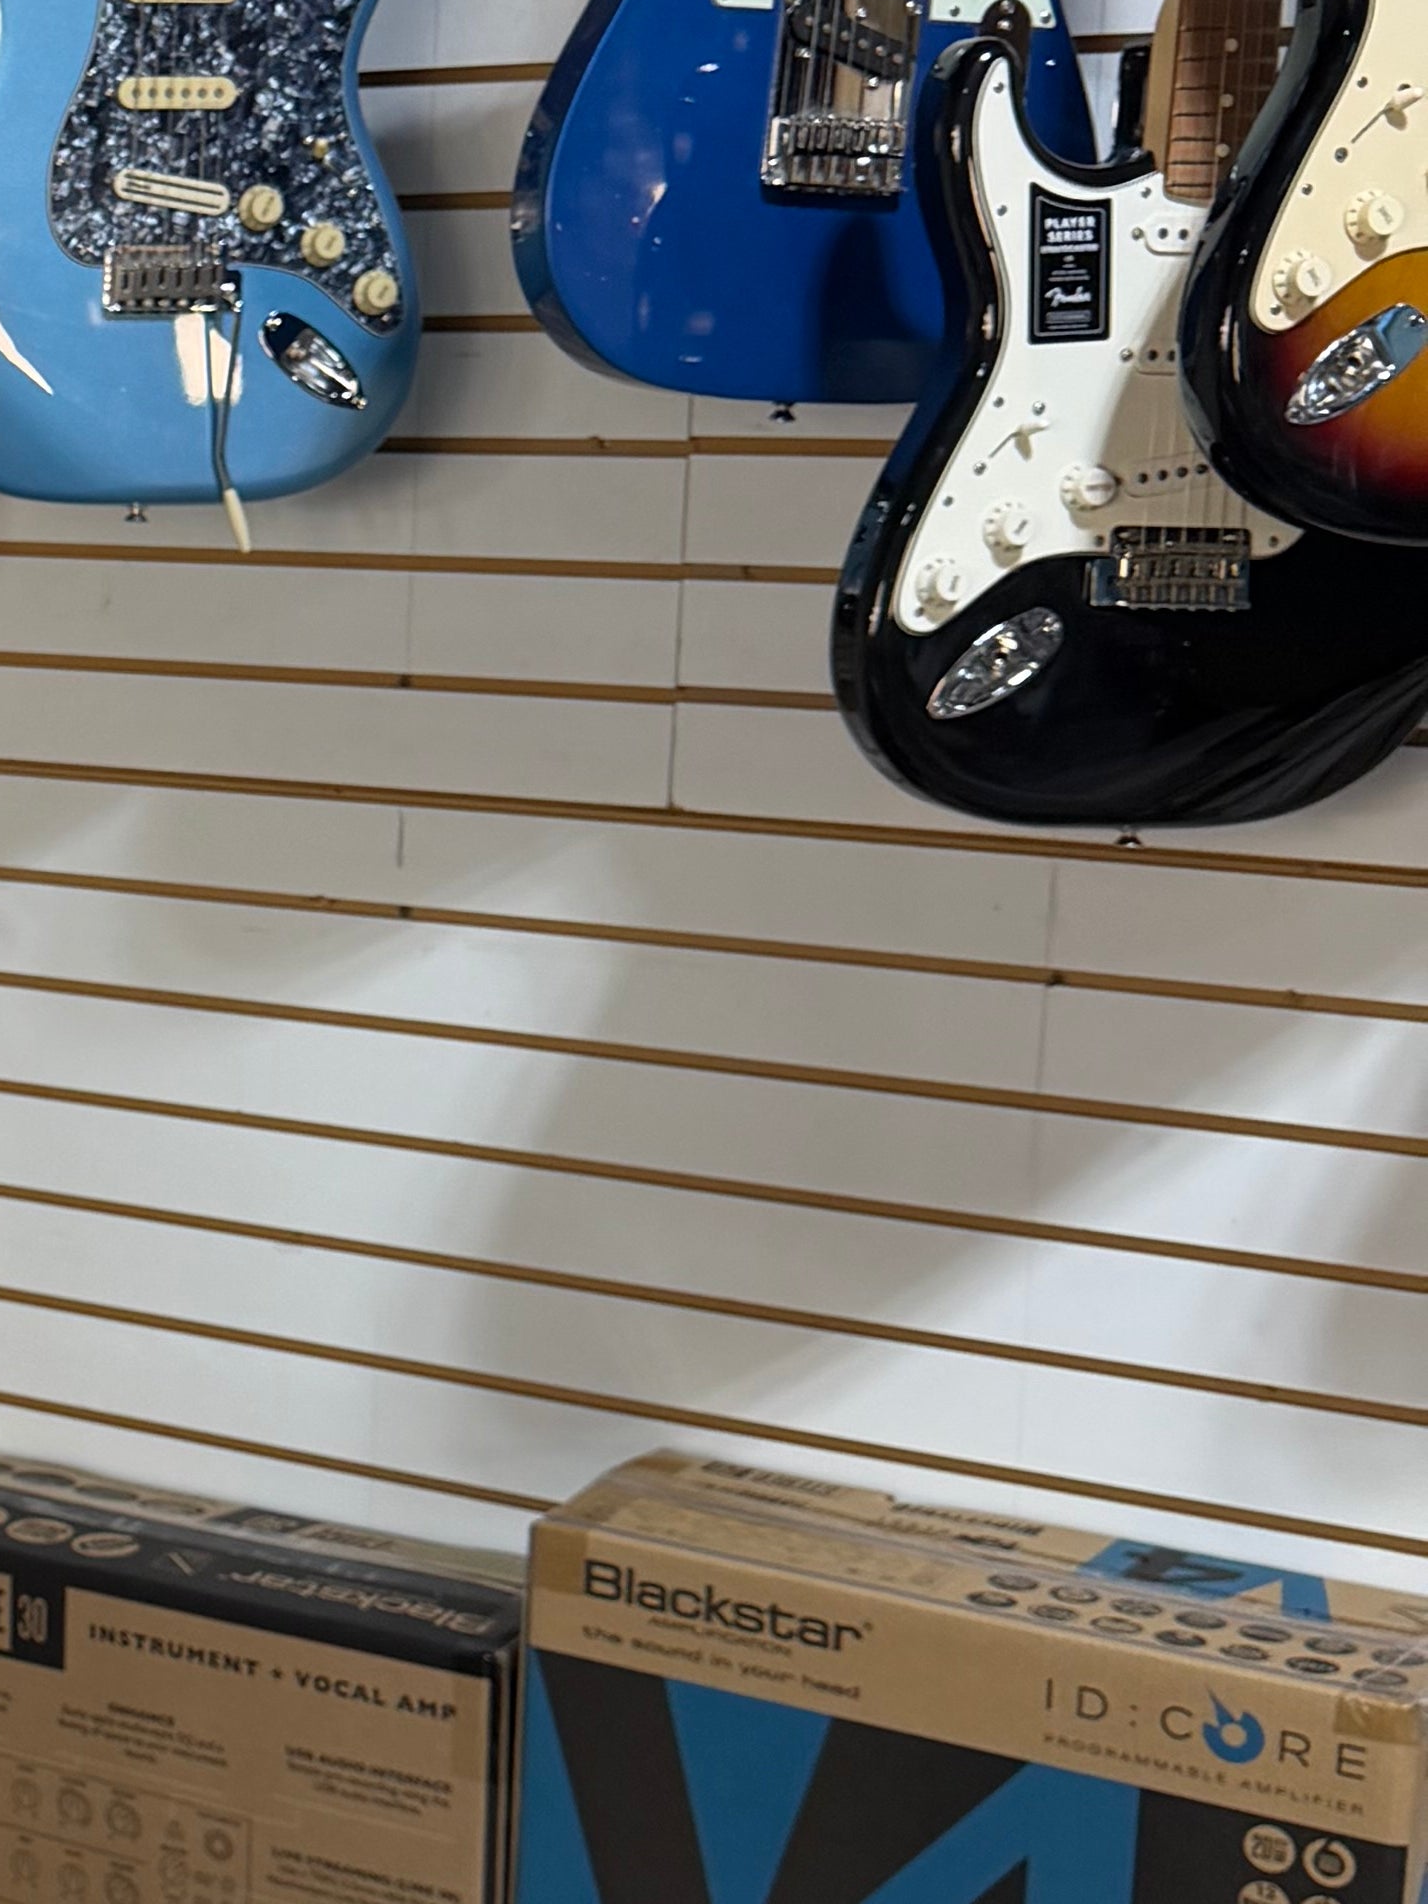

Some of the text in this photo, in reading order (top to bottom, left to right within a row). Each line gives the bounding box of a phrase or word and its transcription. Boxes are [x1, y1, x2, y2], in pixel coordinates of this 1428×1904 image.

[1043, 215, 1097, 230] PLAYER
[1046, 229, 1095, 244] SERIES
[582, 1557, 864, 1652] Blackstar
[88, 1621, 260, 1680] INSTRUMENT
[295, 1667, 386, 1707] VOCAL
[397, 1693, 459, 1722] AMP
